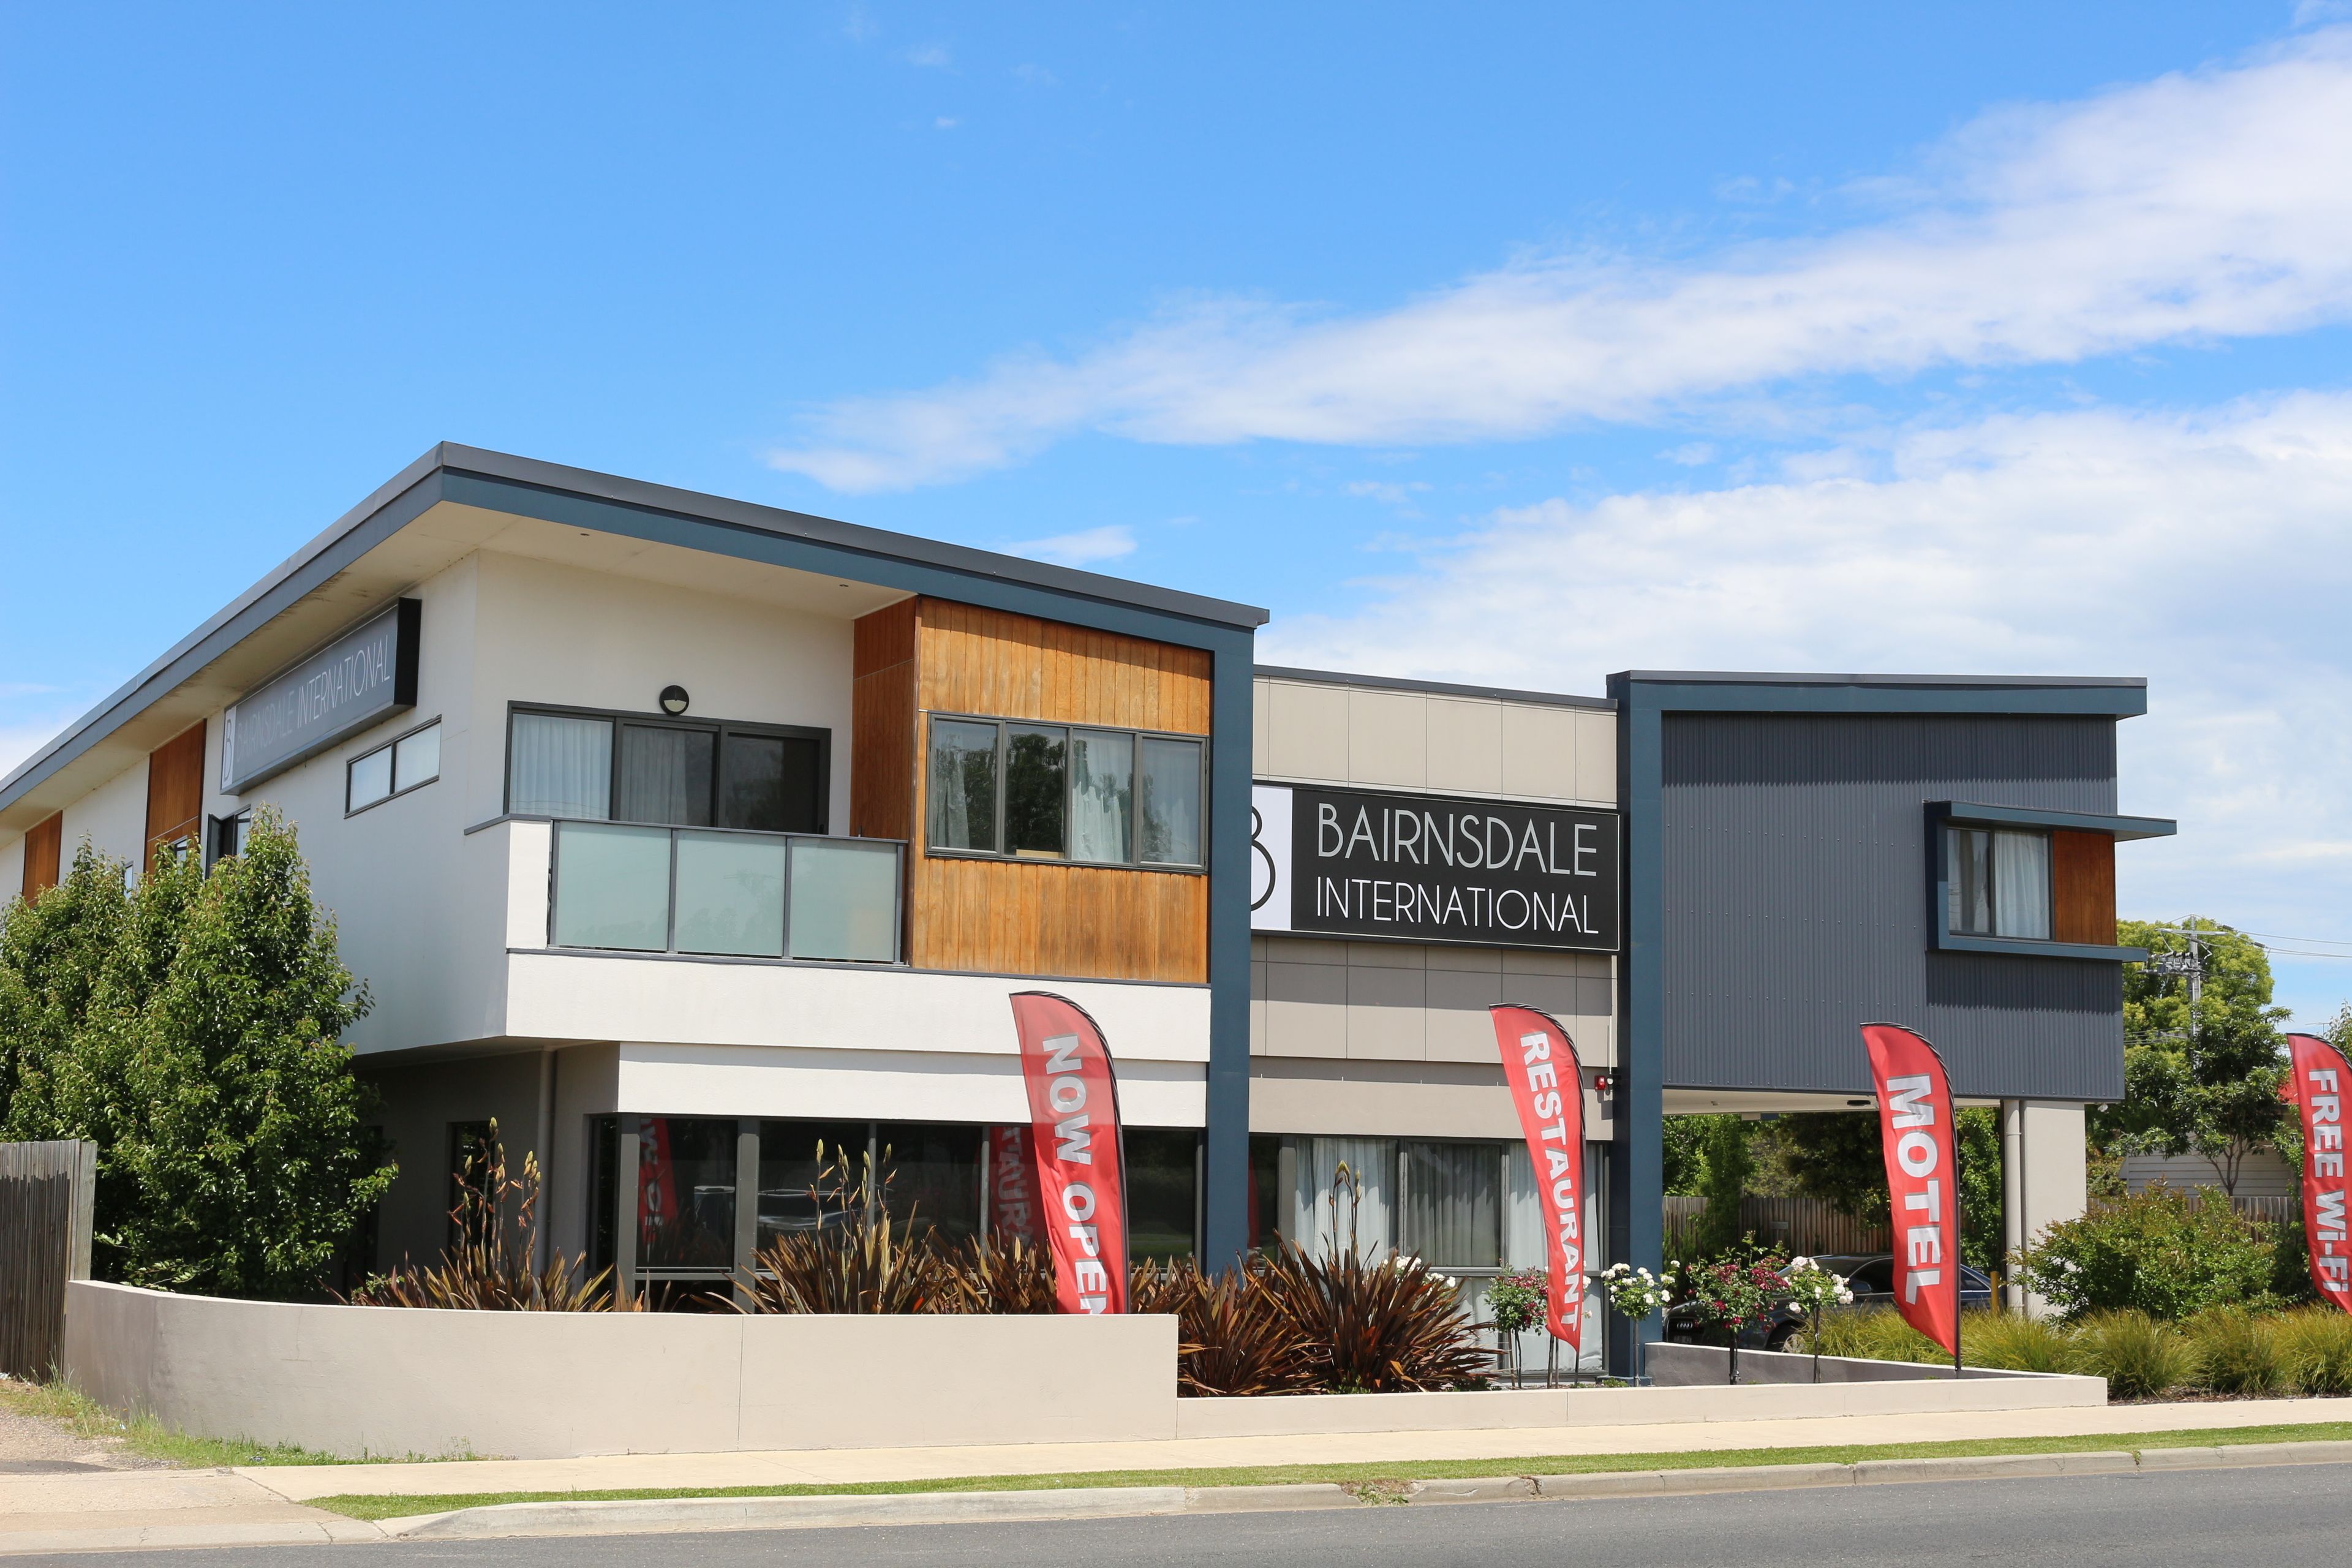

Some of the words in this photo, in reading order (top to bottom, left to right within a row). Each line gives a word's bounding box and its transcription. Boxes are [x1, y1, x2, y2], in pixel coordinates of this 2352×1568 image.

[235, 690, 295, 763] BAIRNSDALE
[297, 635, 390, 729] INTERNATIONAL
[1317, 802, 1597, 877] BAIRNSDALE
[1317, 876, 1599, 935] INTERNATIONAL
[1042, 1033, 1092, 1166] NOW
[2309, 1068, 2344, 1178] FREE
[1520, 1030, 1580, 1332] RESTAURANT
[1886, 1072, 1940, 1306] MOTEL
[2315, 1189, 2348, 1293] Wi-Fi
